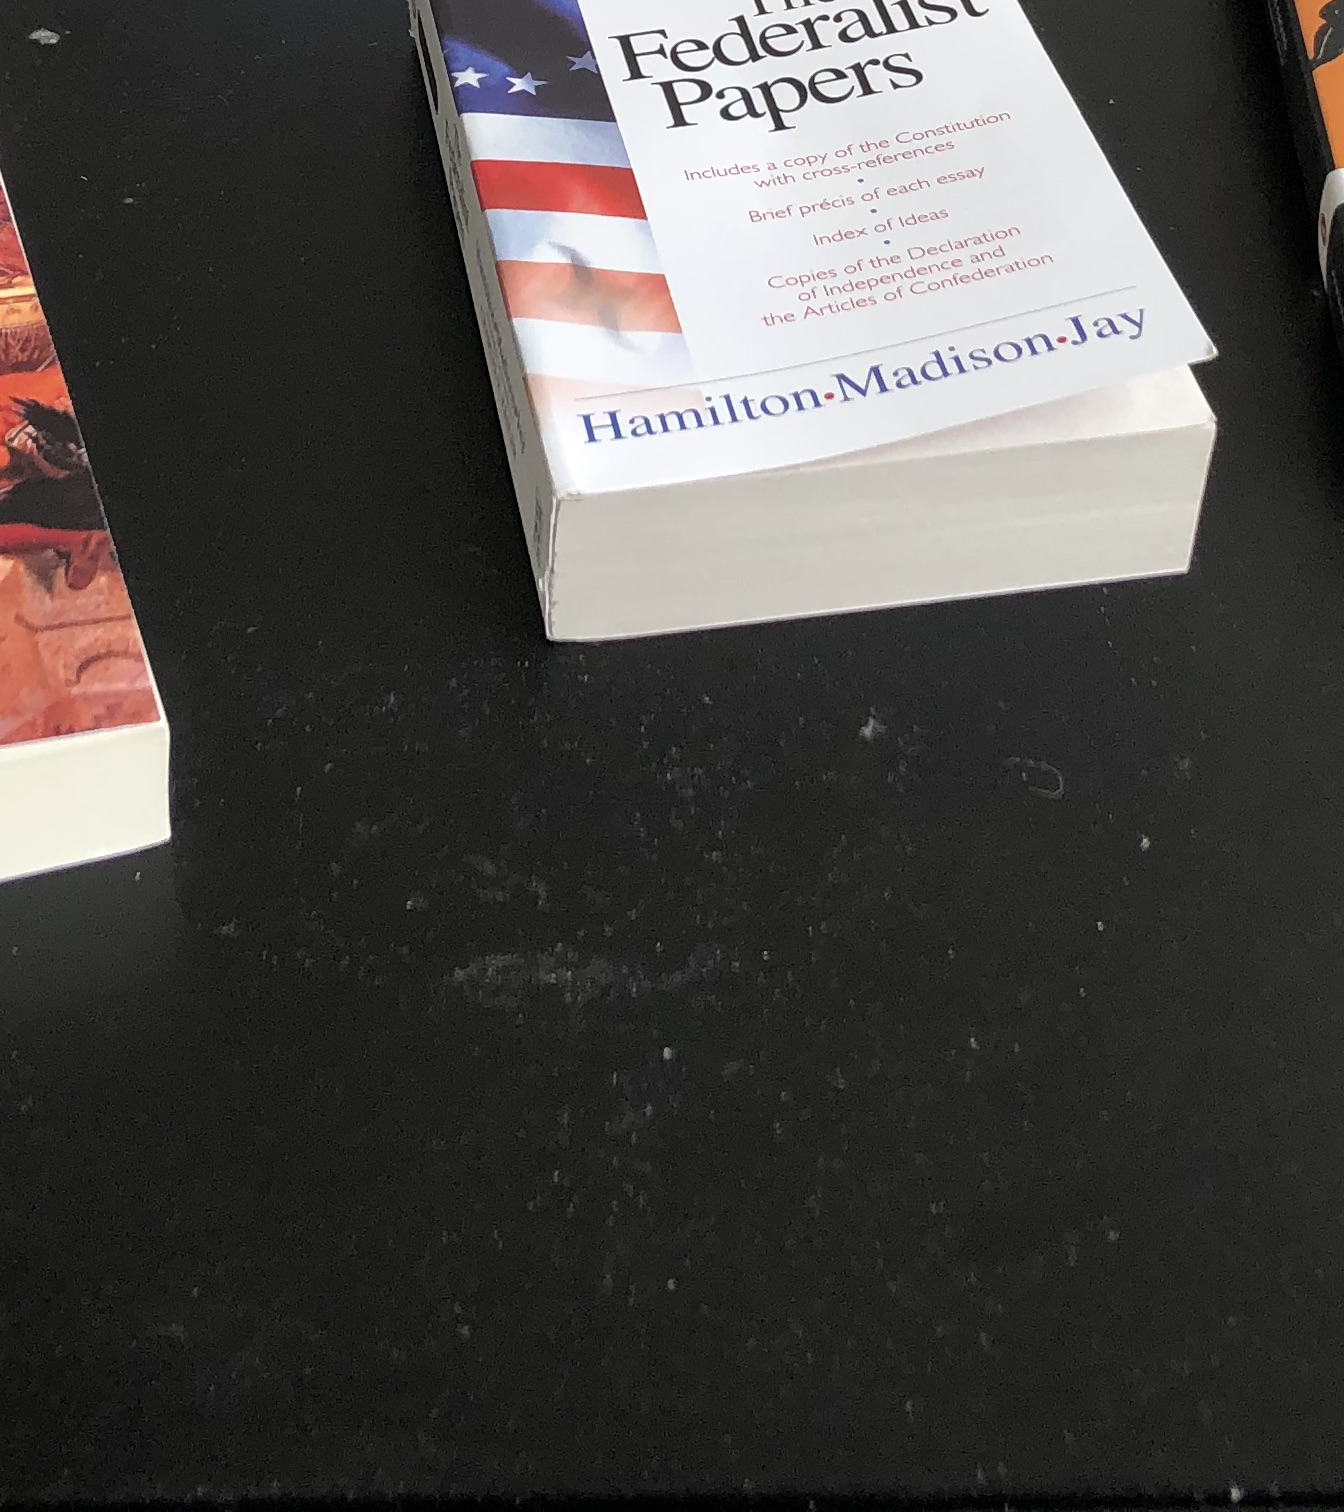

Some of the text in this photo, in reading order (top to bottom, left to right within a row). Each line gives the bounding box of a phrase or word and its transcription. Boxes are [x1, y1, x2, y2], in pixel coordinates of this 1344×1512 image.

[650, 51, 924, 133] Papers
[684, 110, 1013, 182] Includes a copy of the Constitution
[753, 139, 956, 189] with cross-references
[748, 165, 987, 224] Brief précis of each essay
[767, 224, 1022, 289] Copies of the Declaration
[813, 207, 951, 247] Index of Ideas
[762, 251, 1055, 327] the Articles of Confederation
[797, 244, 1007, 302] of Independence and
